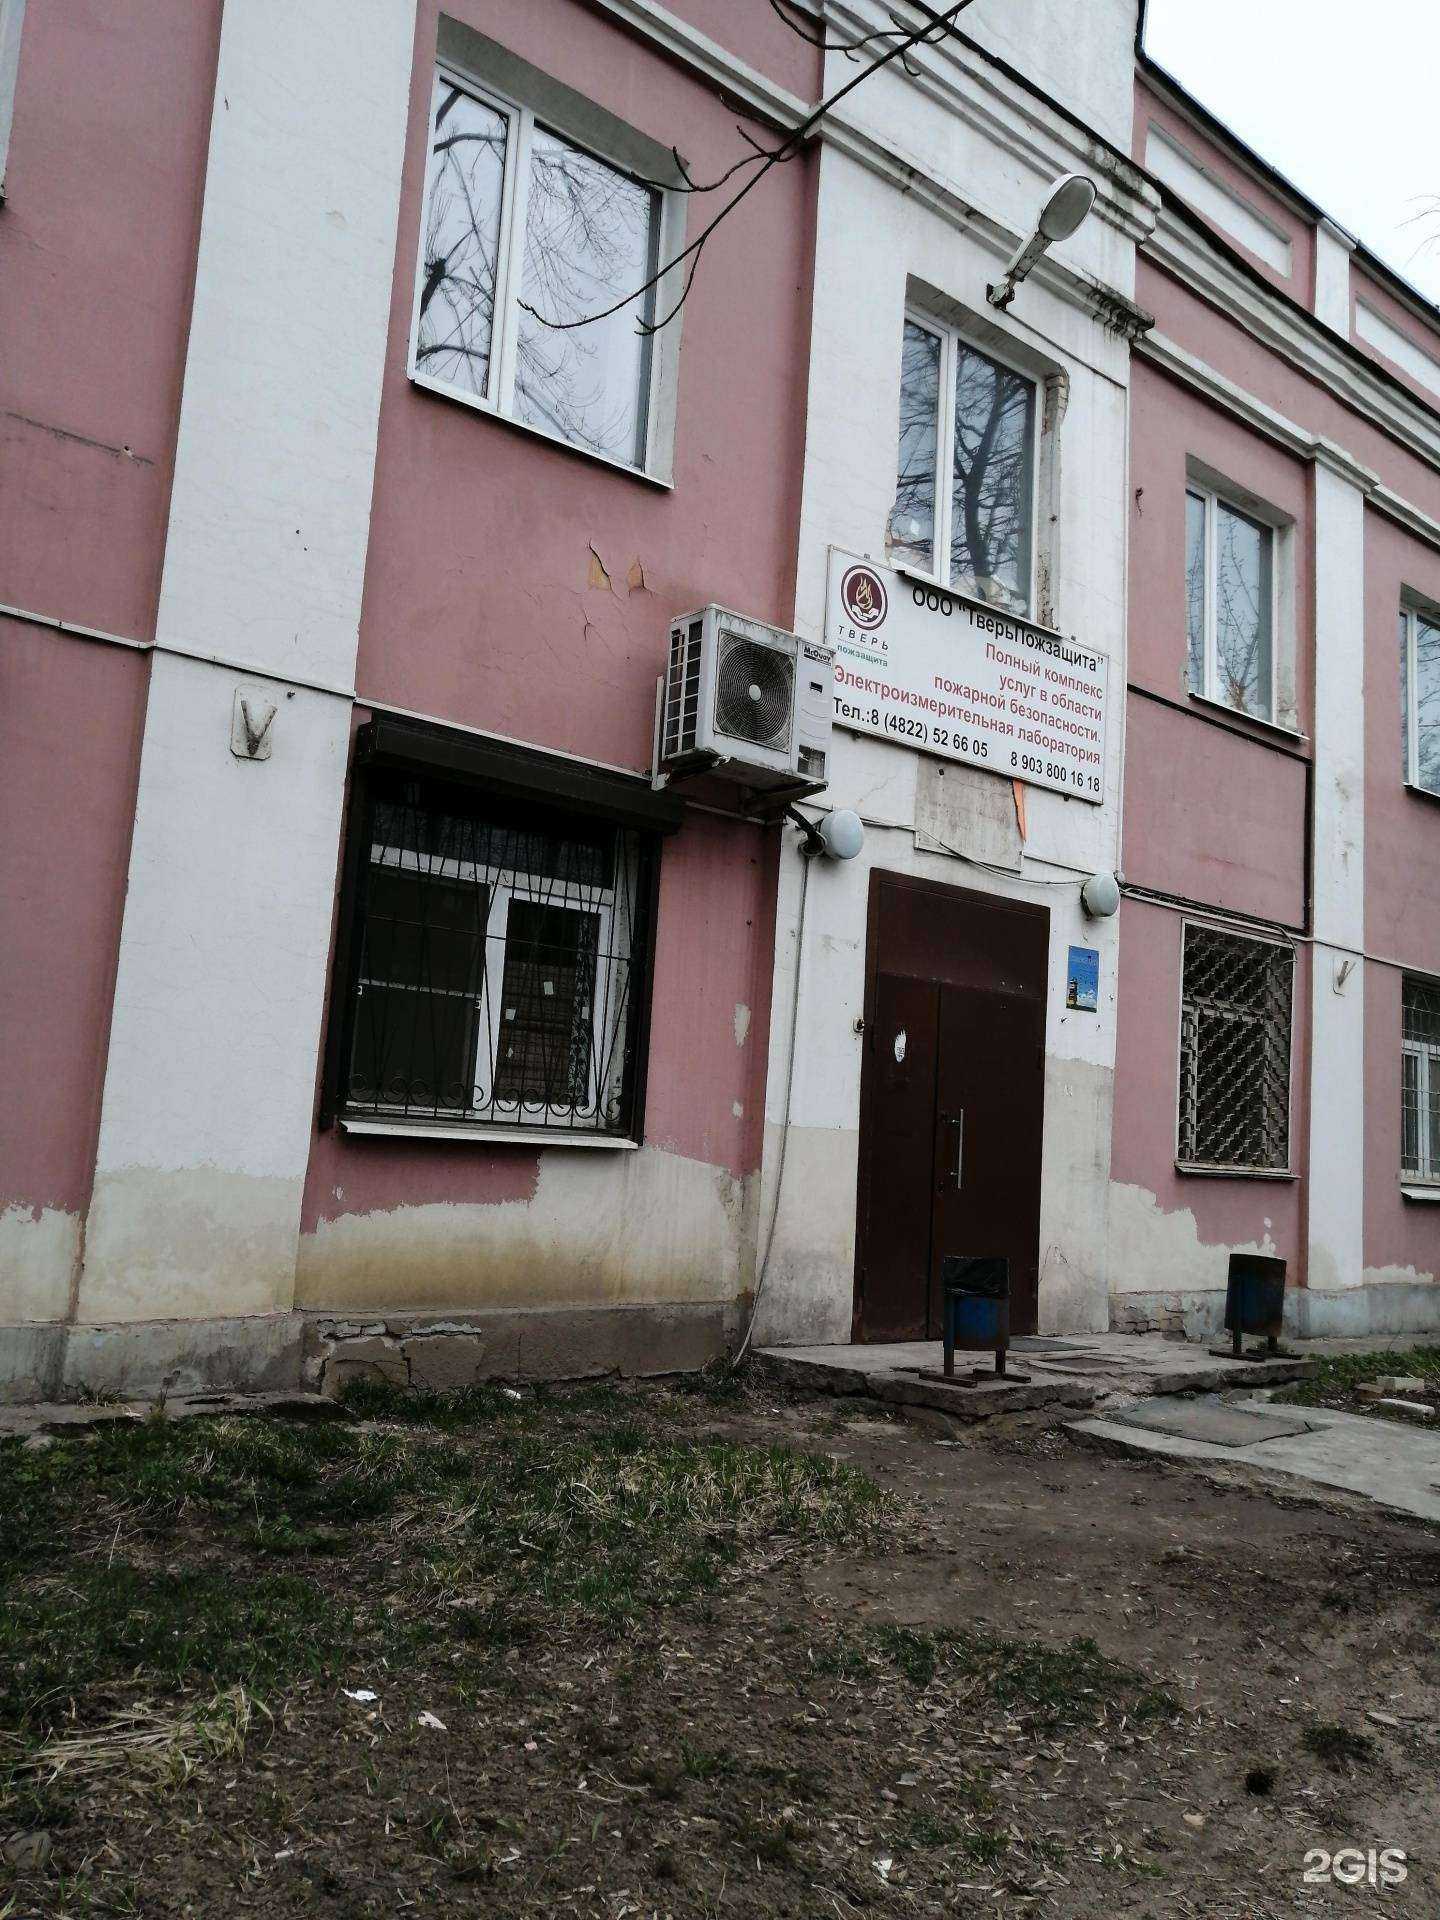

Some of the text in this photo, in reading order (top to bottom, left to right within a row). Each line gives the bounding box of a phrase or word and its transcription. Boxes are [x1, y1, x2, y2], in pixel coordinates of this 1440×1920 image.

[913, 586, 952, 616] ООО
[837, 644, 888, 666] пожзащита
[838, 625, 889, 651] ТВЕРЬ
[986, 642, 1103, 699] Полный комплекс
[834, 664, 1100, 764] Электроизмерительная лаборатория
[934, 676, 1101, 742] пожарной безопасности.
[999, 674, 1102, 722] услуг в области
[884, 712, 928, 743] (4822)
[933, 728, 948, 746] 52
[953, 733, 968, 752] 66
[973, 739, 988, 757] 05
[1011, 752, 1017, 766] 8
[1022, 755, 1042, 774] 903
[1046, 762, 1067, 782] 800
[1072, 770, 1084, 788] 16
[1088, 776, 1100, 792] 18
